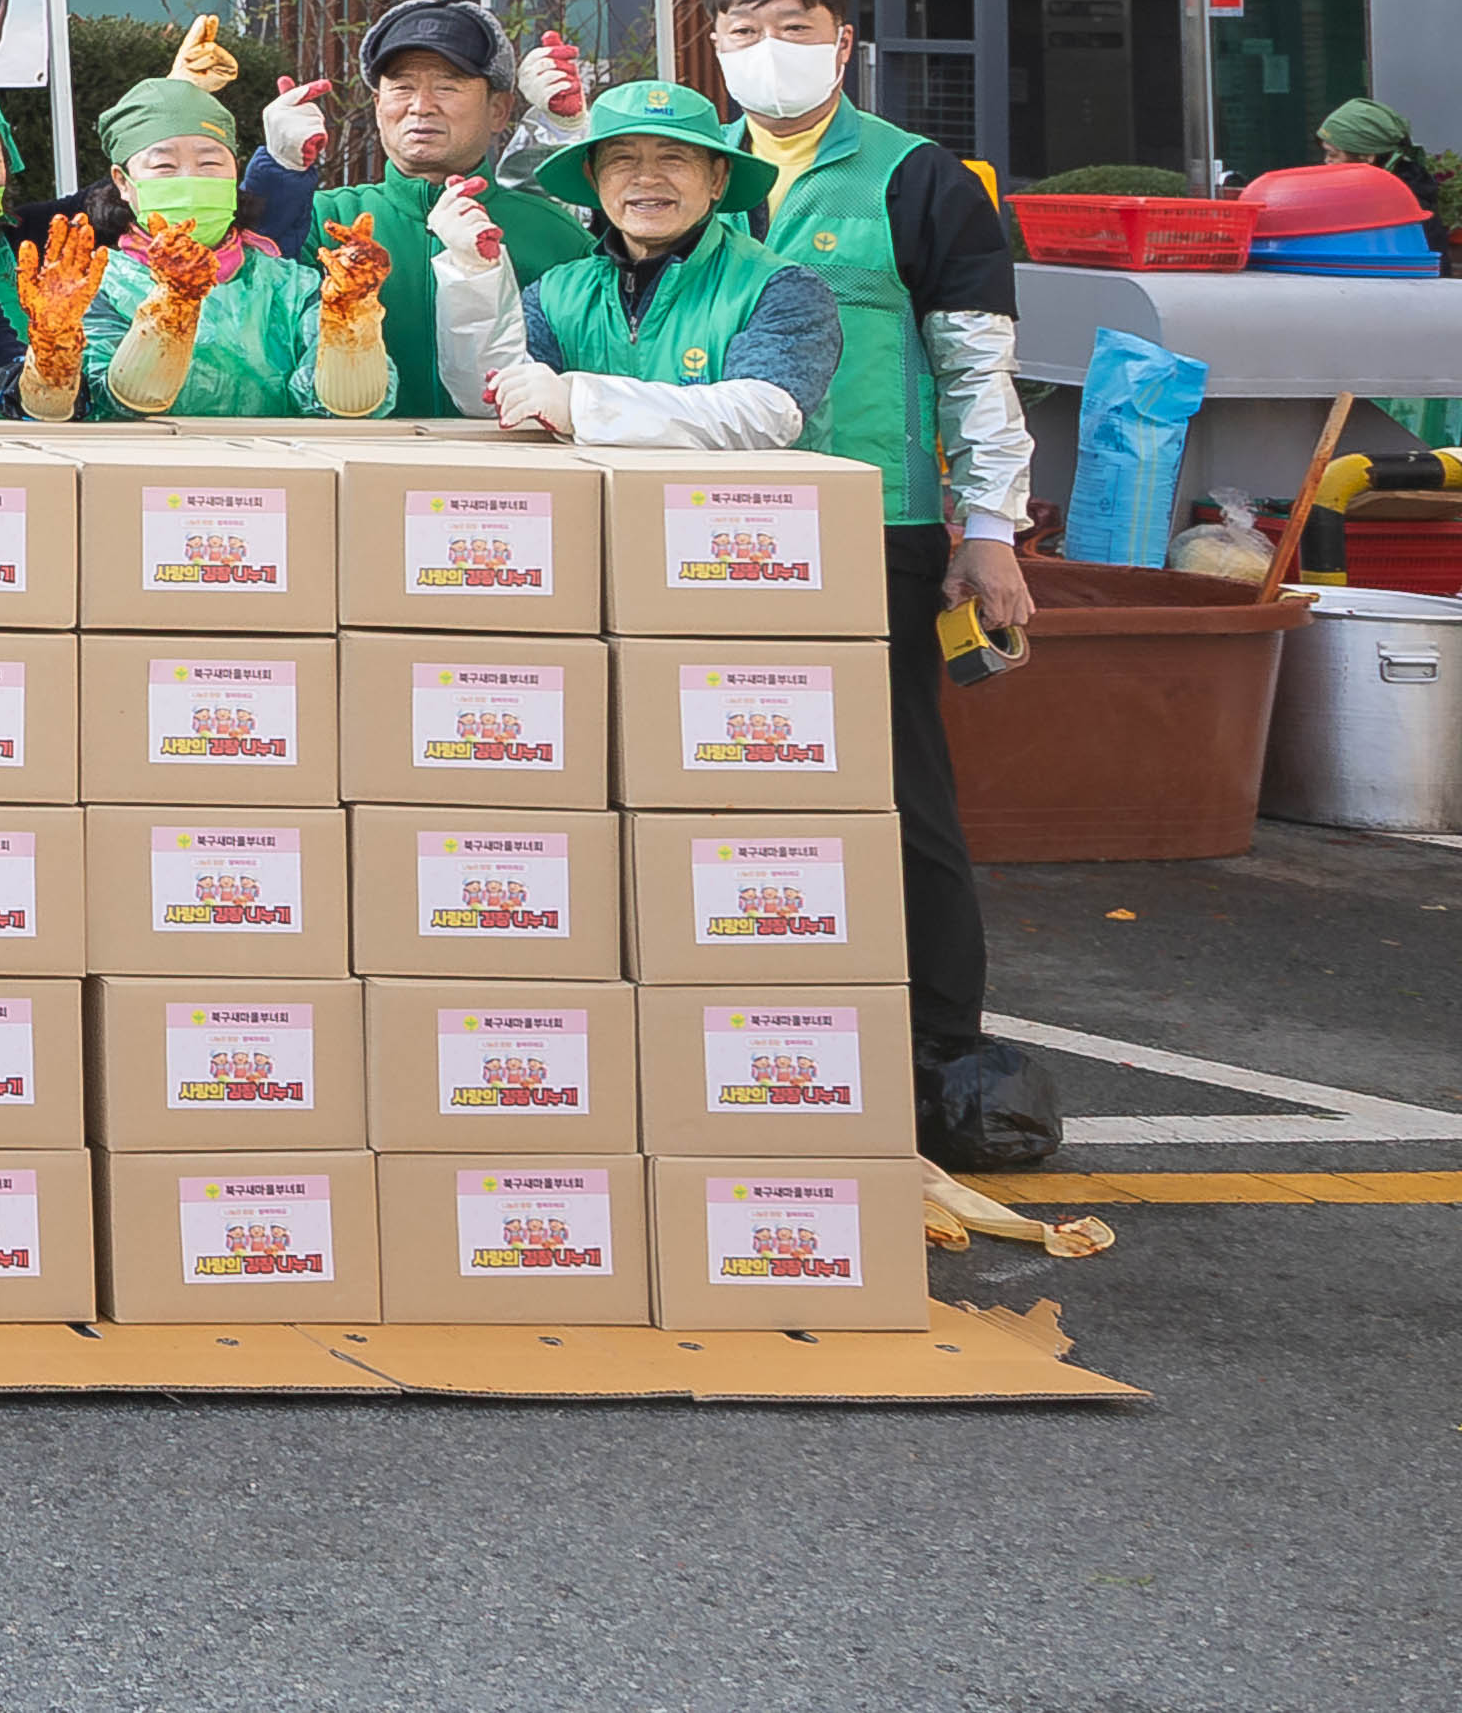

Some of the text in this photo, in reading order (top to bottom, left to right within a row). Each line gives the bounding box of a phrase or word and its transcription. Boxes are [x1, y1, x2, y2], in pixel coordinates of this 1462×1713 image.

[711, 493, 793, 503] 북구새마을부녀회
[678, 560, 809, 581] 사랑의 김장 나누기
[464, 840, 543, 851] 북구새마을부녀회
[430, 908, 558, 929] 사랑의 김장 나누기
[211, 1011, 289, 1022] 북구새마을부녀회
[484, 1017, 563, 1028] 북구새마을부녀회
[178, 1081, 302, 1100] 사랑의 김장 나누기
[450, 1086, 577, 1106] 사랑의 김장 나누기
